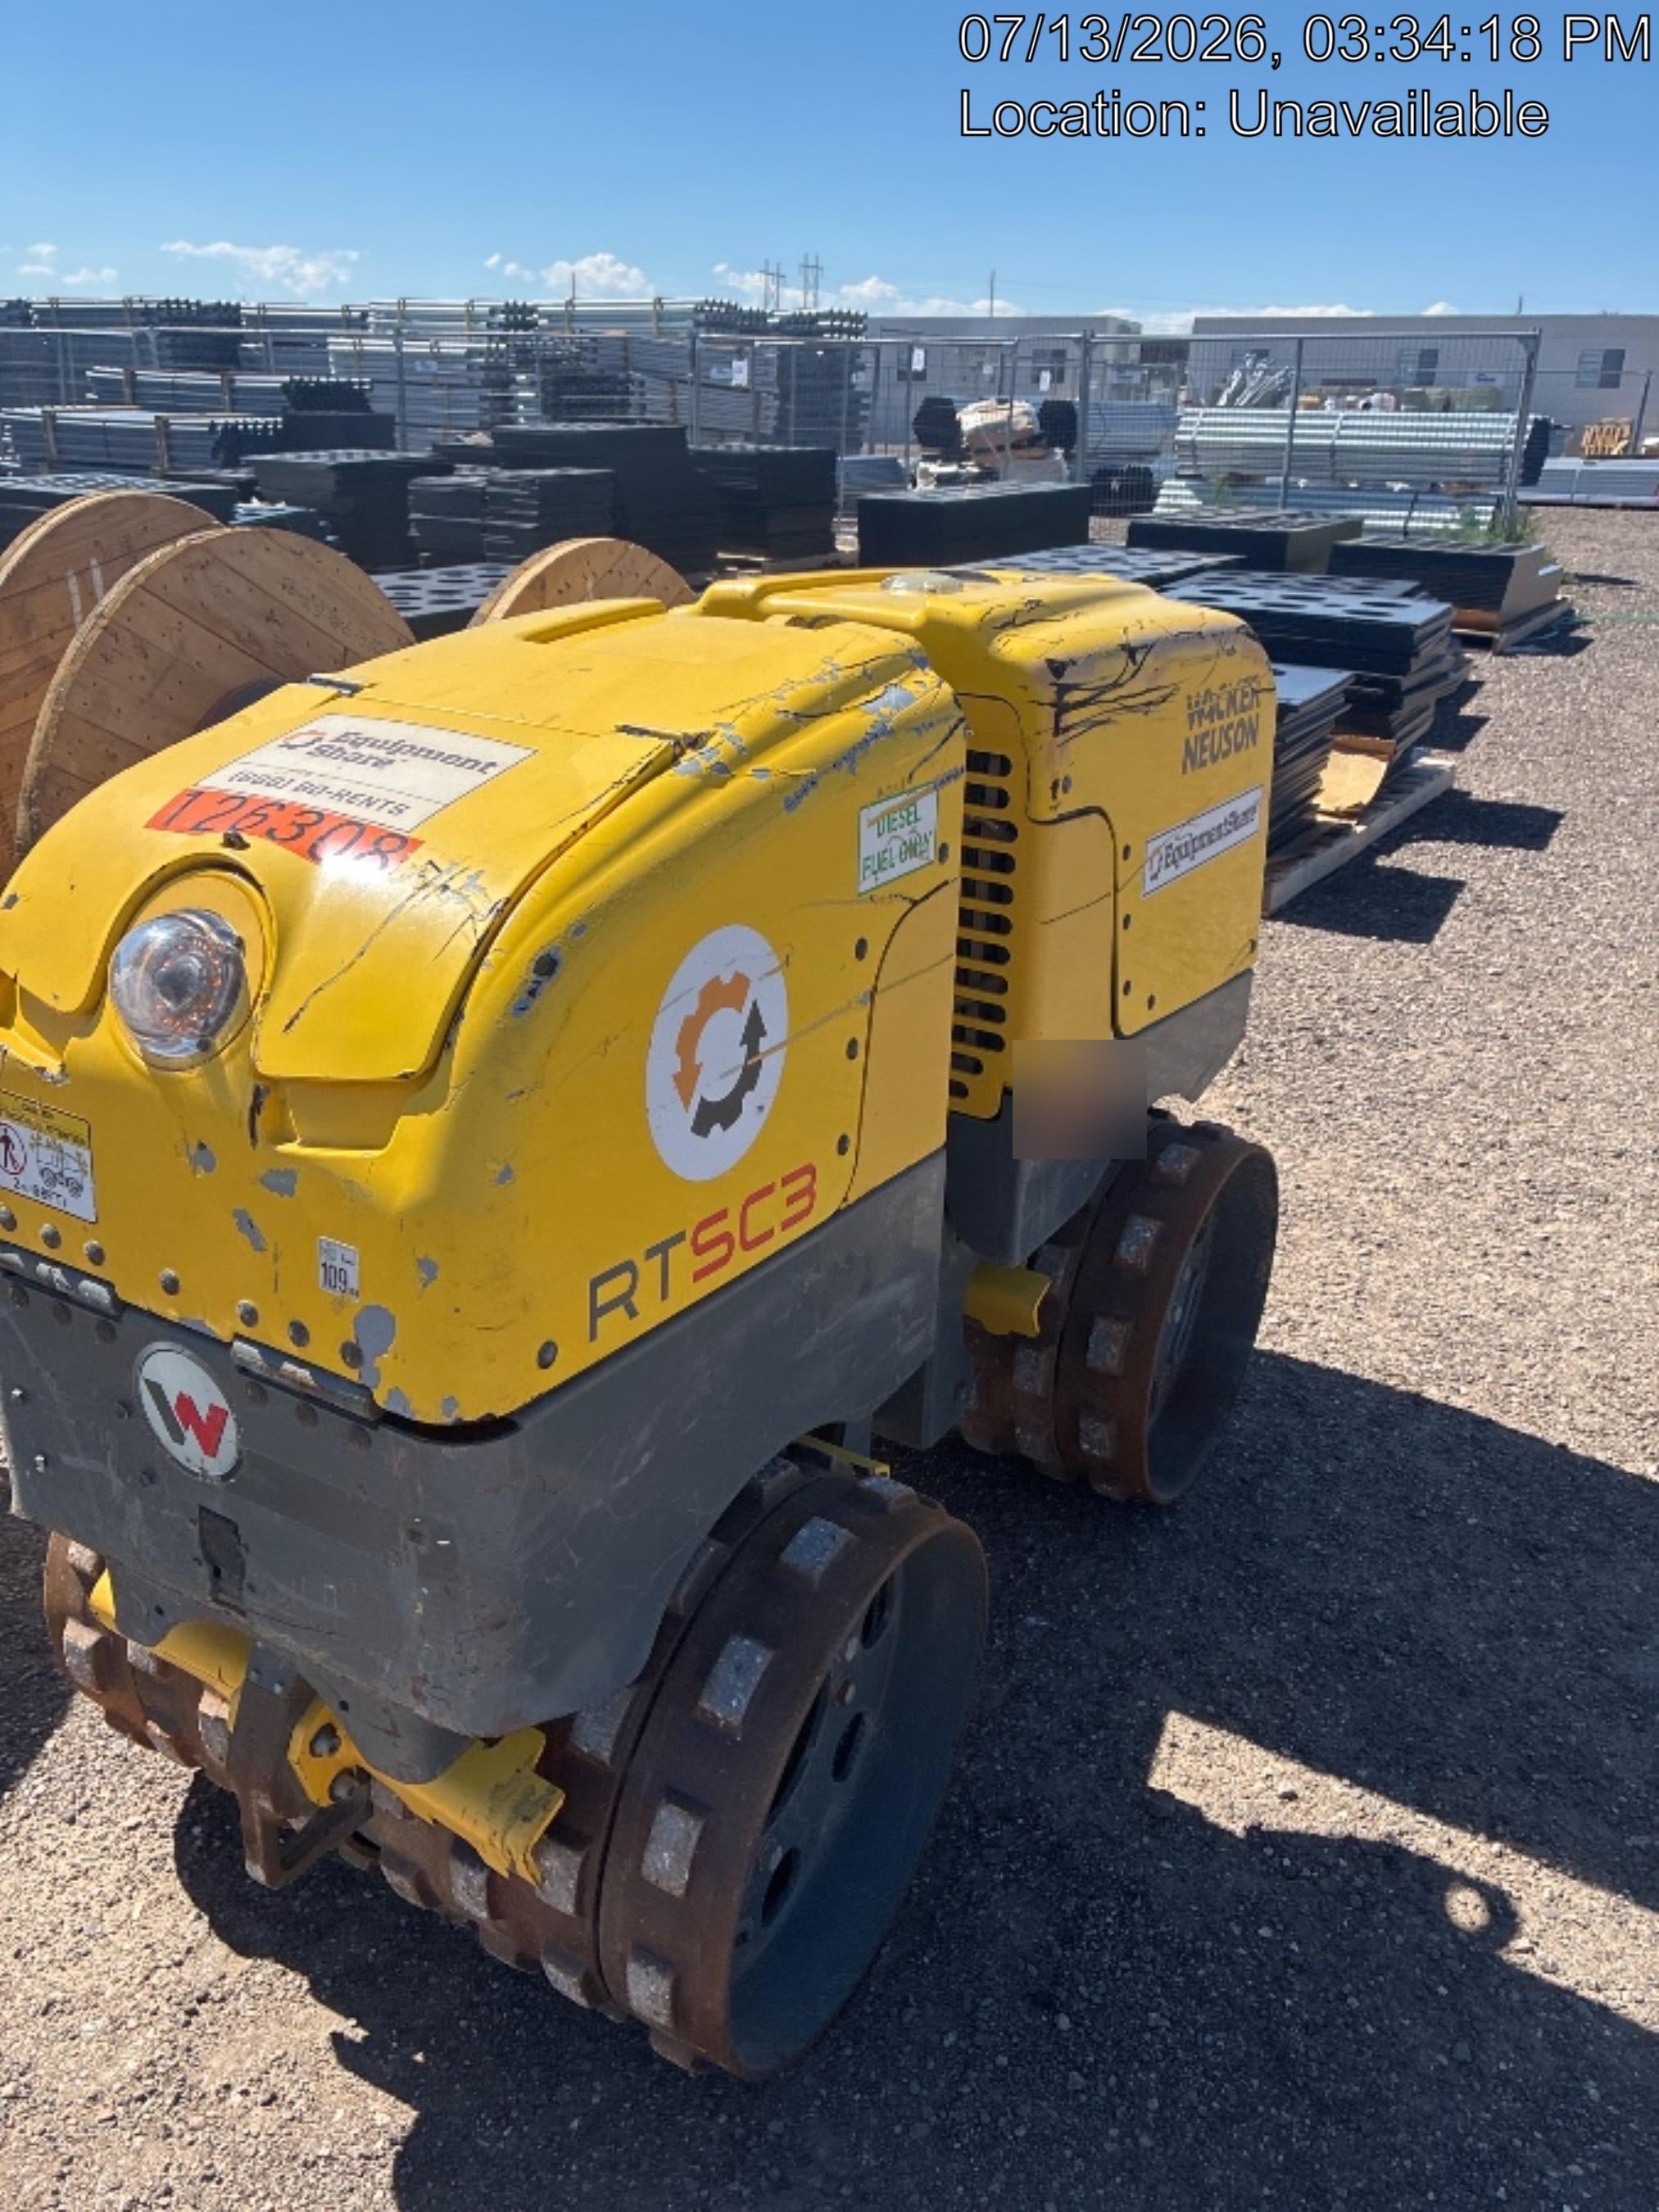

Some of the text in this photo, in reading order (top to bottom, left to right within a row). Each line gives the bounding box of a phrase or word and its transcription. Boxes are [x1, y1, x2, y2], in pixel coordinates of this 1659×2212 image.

[329, 731, 497, 775] Equipment
[1181, 712, 1259, 775] NEUSON
[163, 790, 409, 870] 126308
[876, 802, 922, 839] DIESEL
[862, 829, 933, 881] FUEL ONLY
[320, 1261, 347, 1294] 109
[588, 1162, 818, 1343] RTSC3
